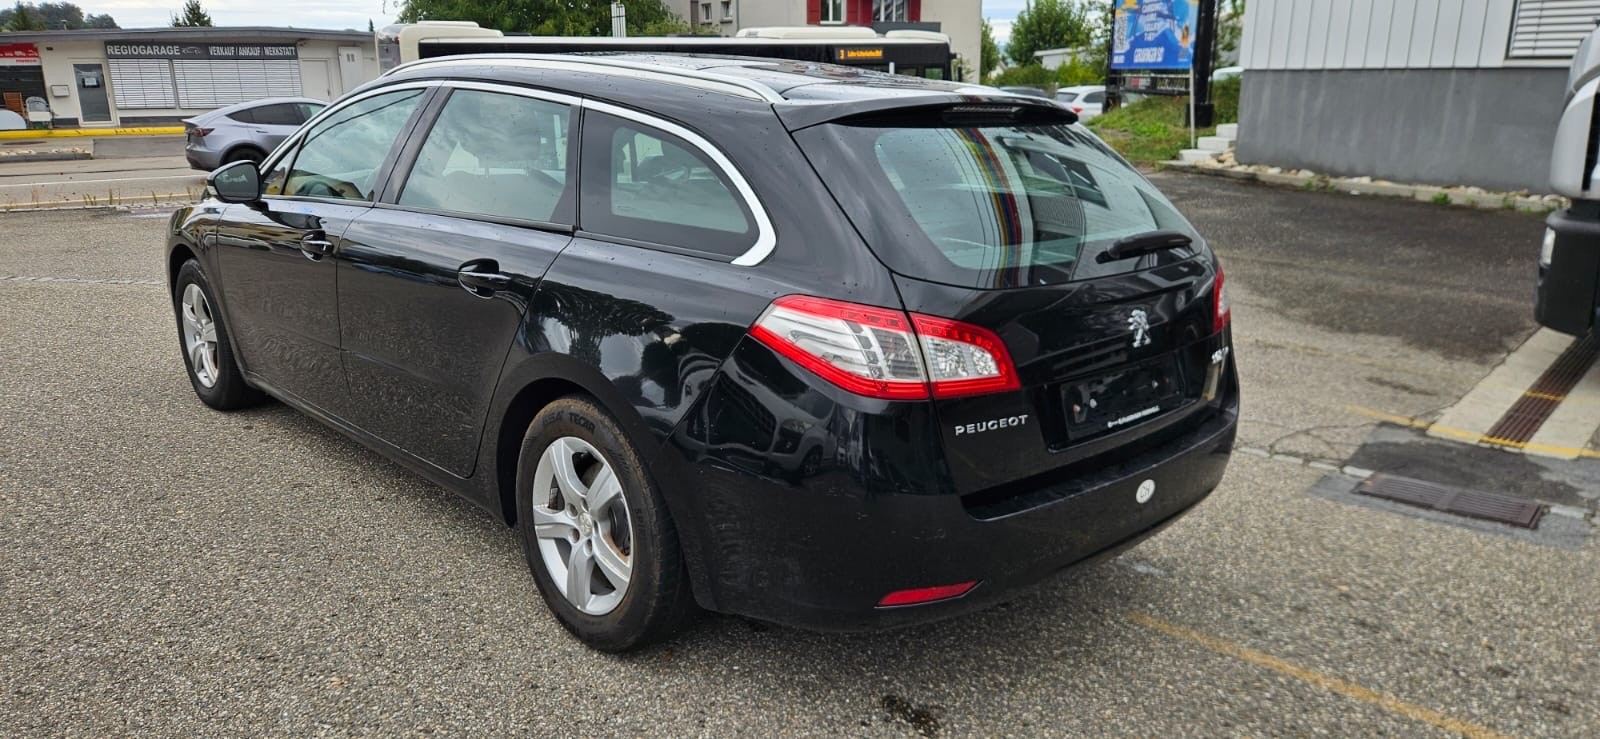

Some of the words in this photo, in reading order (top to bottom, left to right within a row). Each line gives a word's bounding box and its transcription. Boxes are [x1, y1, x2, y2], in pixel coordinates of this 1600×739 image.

[106, 45, 180, 55] REGIOGARAGE
[208, 46, 235, 56] VERKAUF
[239, 46, 261, 56] ANKAUF
[264, 46, 296, 56] WERKSTATT
[954, 414, 1029, 436] PEUGEOT
